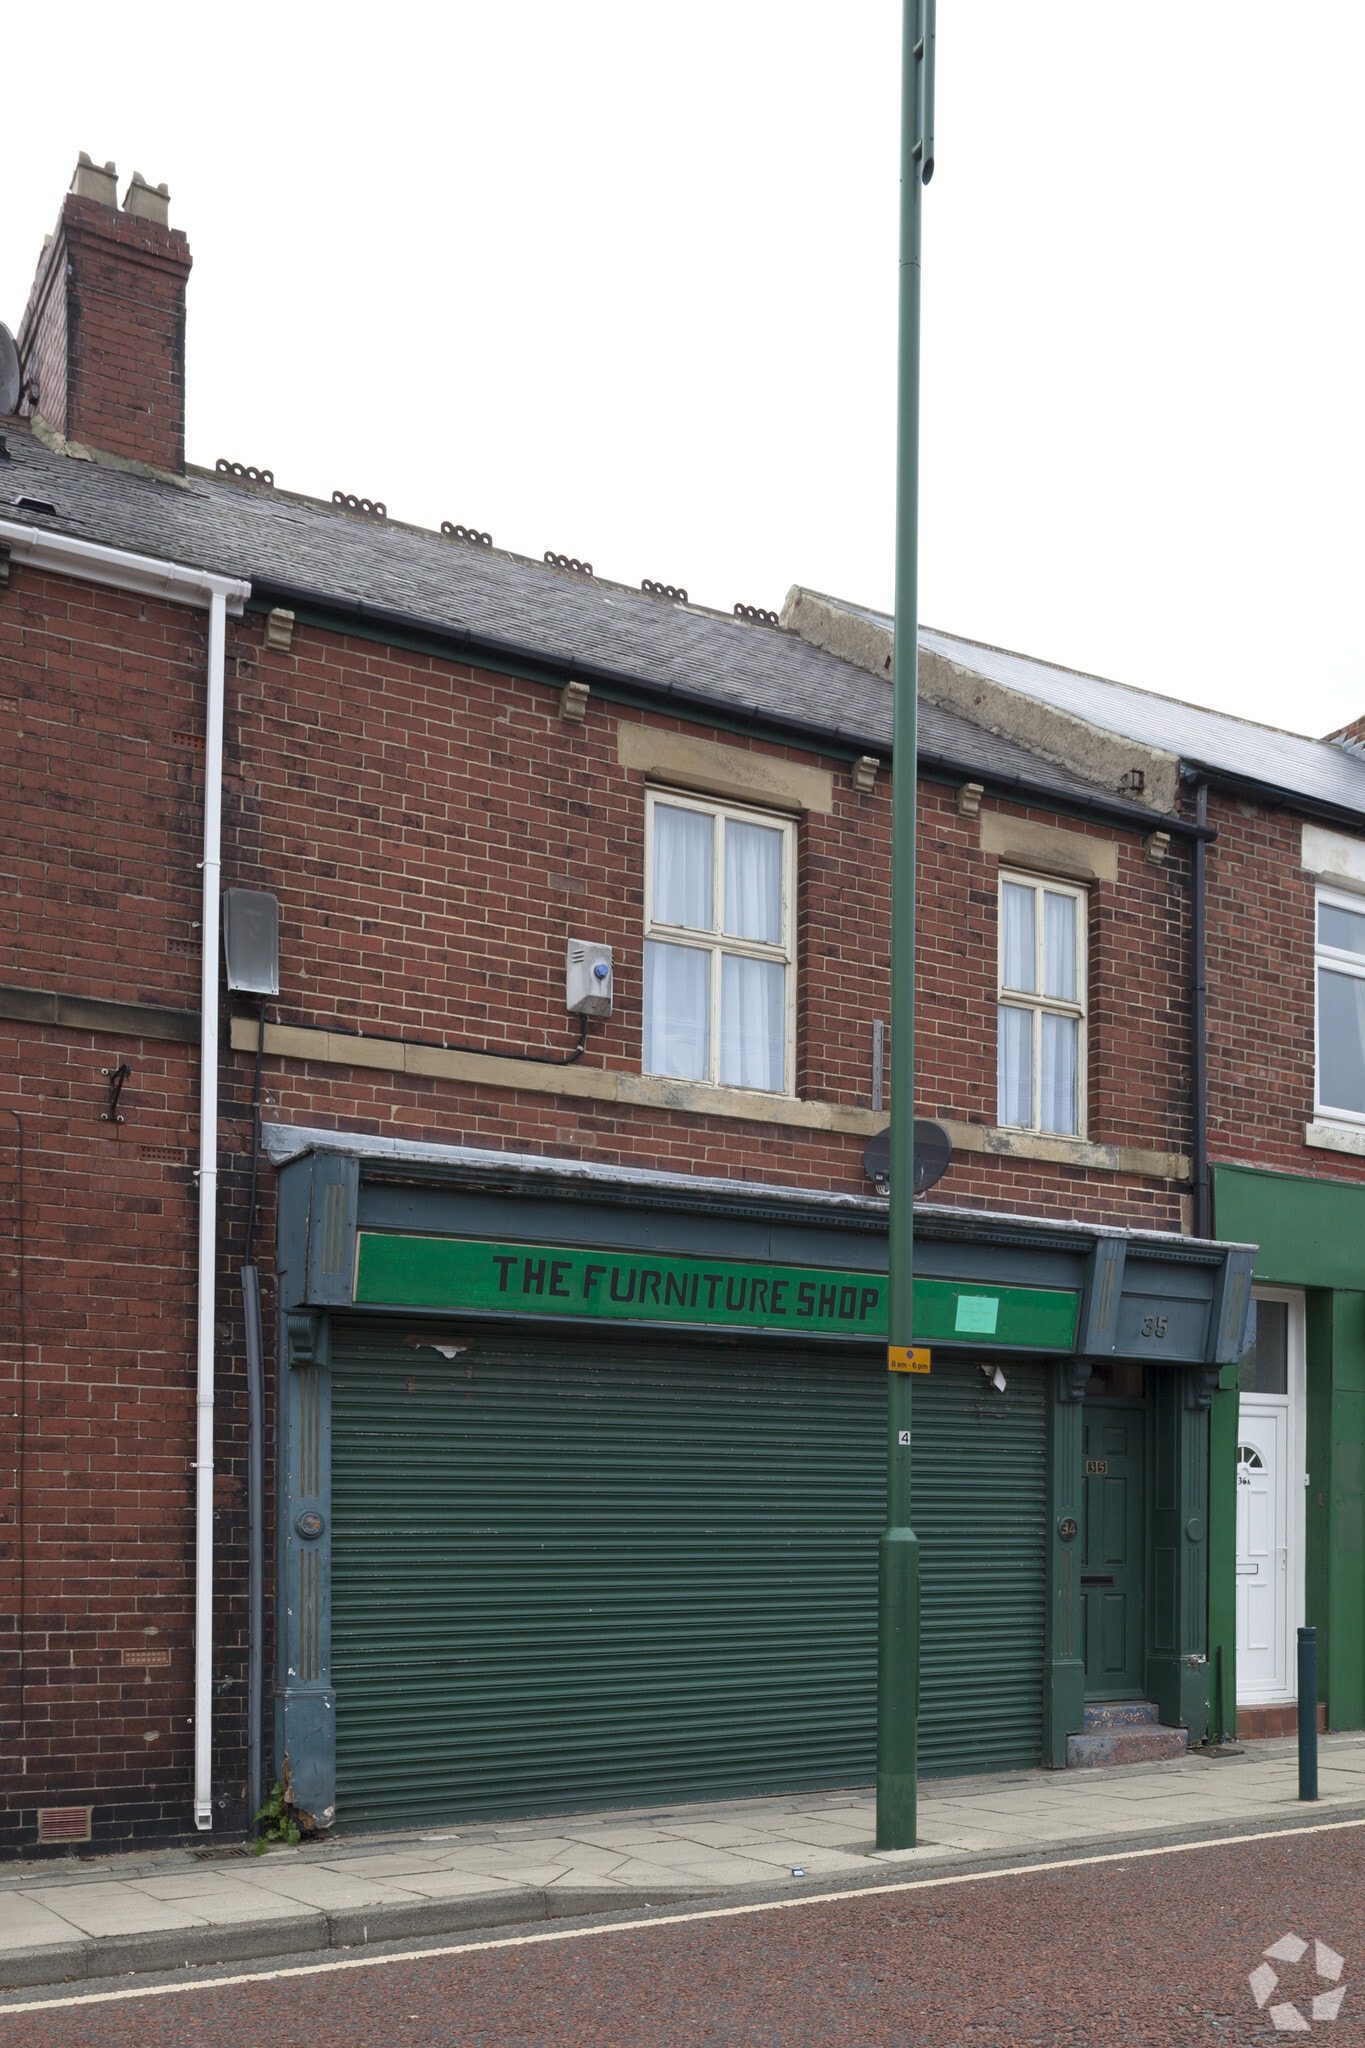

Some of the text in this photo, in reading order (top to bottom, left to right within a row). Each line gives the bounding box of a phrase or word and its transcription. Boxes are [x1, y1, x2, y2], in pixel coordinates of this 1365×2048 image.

[492, 1255, 879, 1321] THE FURNITURE SHOP
[1141, 1314, 1169, 1339] 35
[901, 1432, 909, 1443] 4
[1089, 1462, 1105, 1473] 35
[1062, 1521, 1076, 1536] 34
